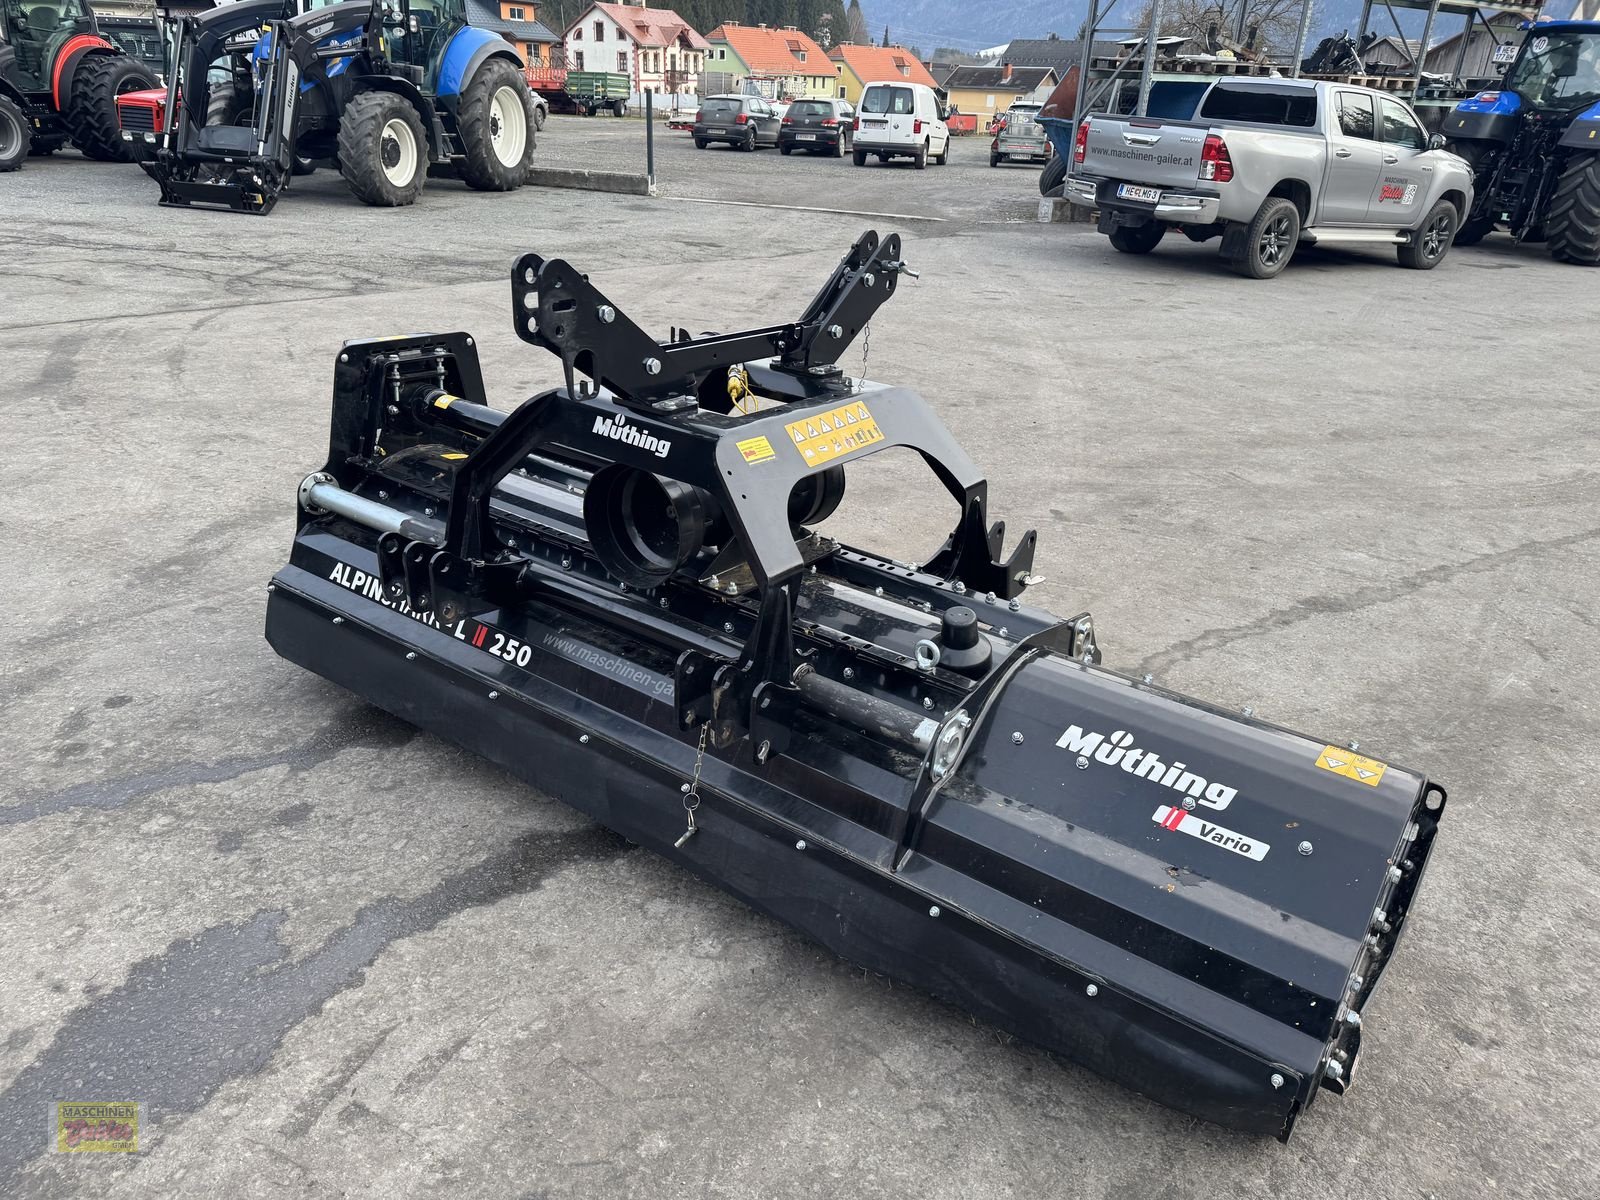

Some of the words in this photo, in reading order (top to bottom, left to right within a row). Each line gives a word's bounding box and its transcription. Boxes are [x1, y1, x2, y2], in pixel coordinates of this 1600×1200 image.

[1534, 39, 1546, 50] 40
[1091, 145, 1193, 166] www.maschinen-gailer.at
[489, 633, 532, 667] 250
[1199, 823, 1252, 854] Vario
